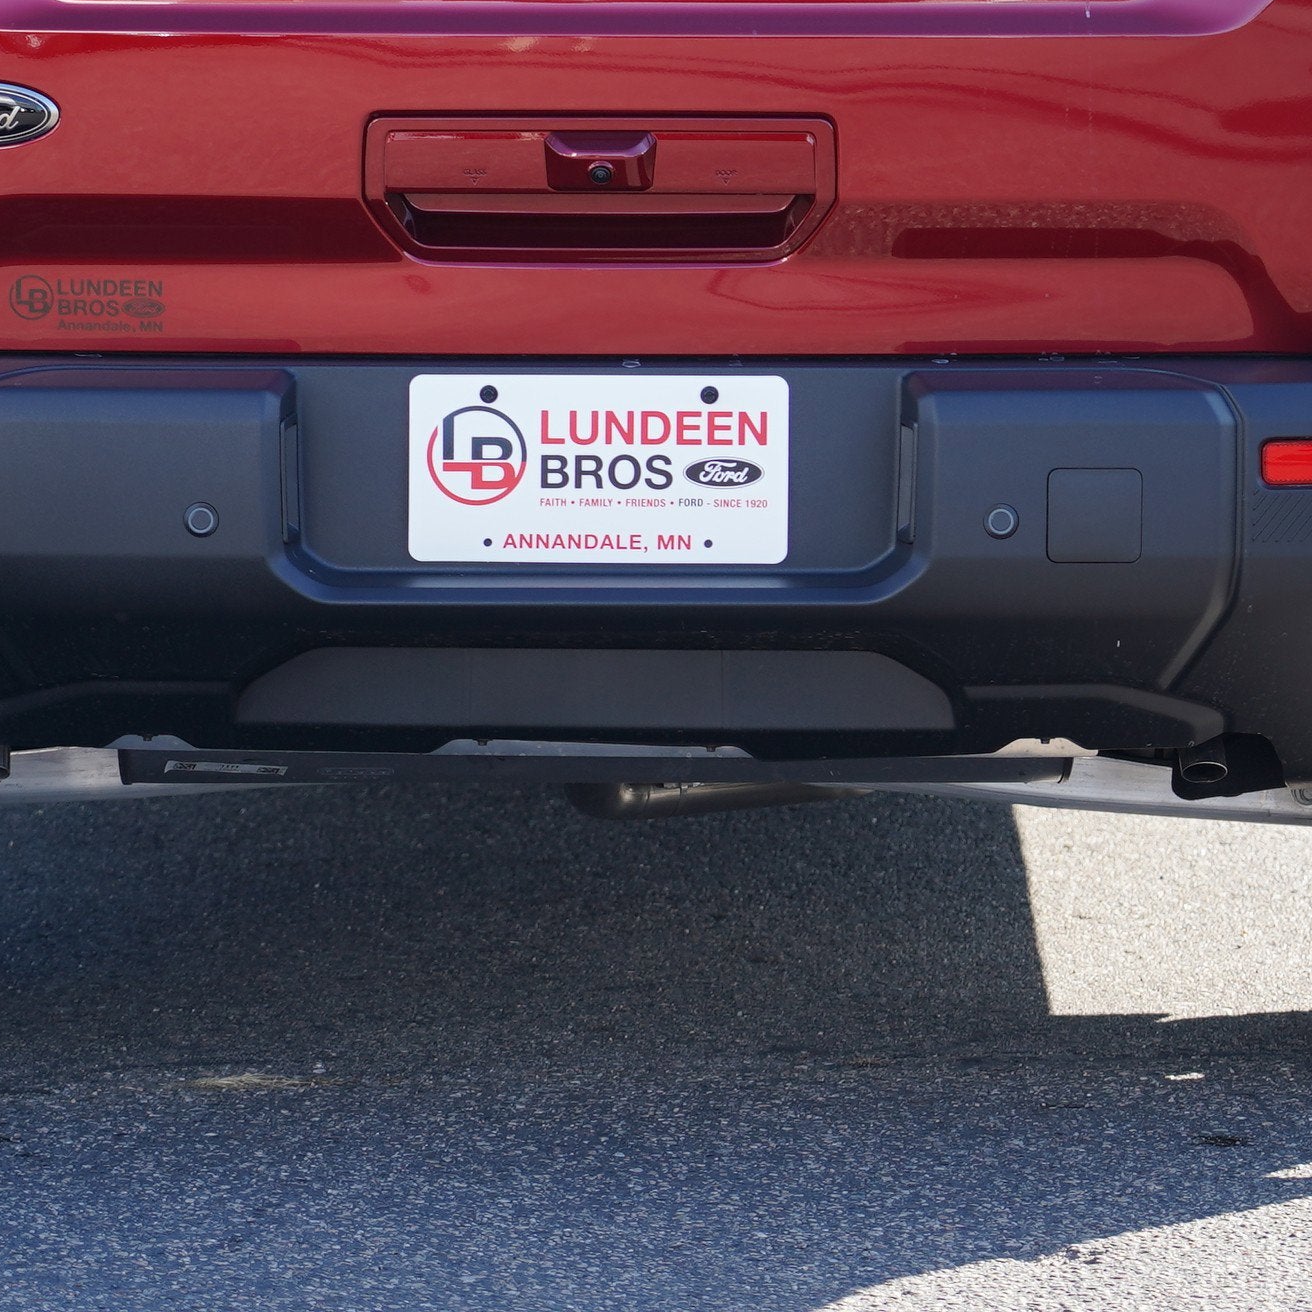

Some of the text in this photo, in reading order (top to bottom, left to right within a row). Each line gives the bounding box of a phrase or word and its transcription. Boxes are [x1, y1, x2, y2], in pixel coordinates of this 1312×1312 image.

[57, 278, 163, 297] LUNDEEN
[57, 298, 120, 317] BROS
[57, 319, 163, 333] Annandale, MN
[540, 410, 768, 446] LUNDEEN
[540, 454, 750, 490] BROS Ford
[539, 498, 768, 508] FAITH FAMILY FRIENDS FORD SINCE 1920
[503, 533, 692, 553] ANNANDALE, MN
